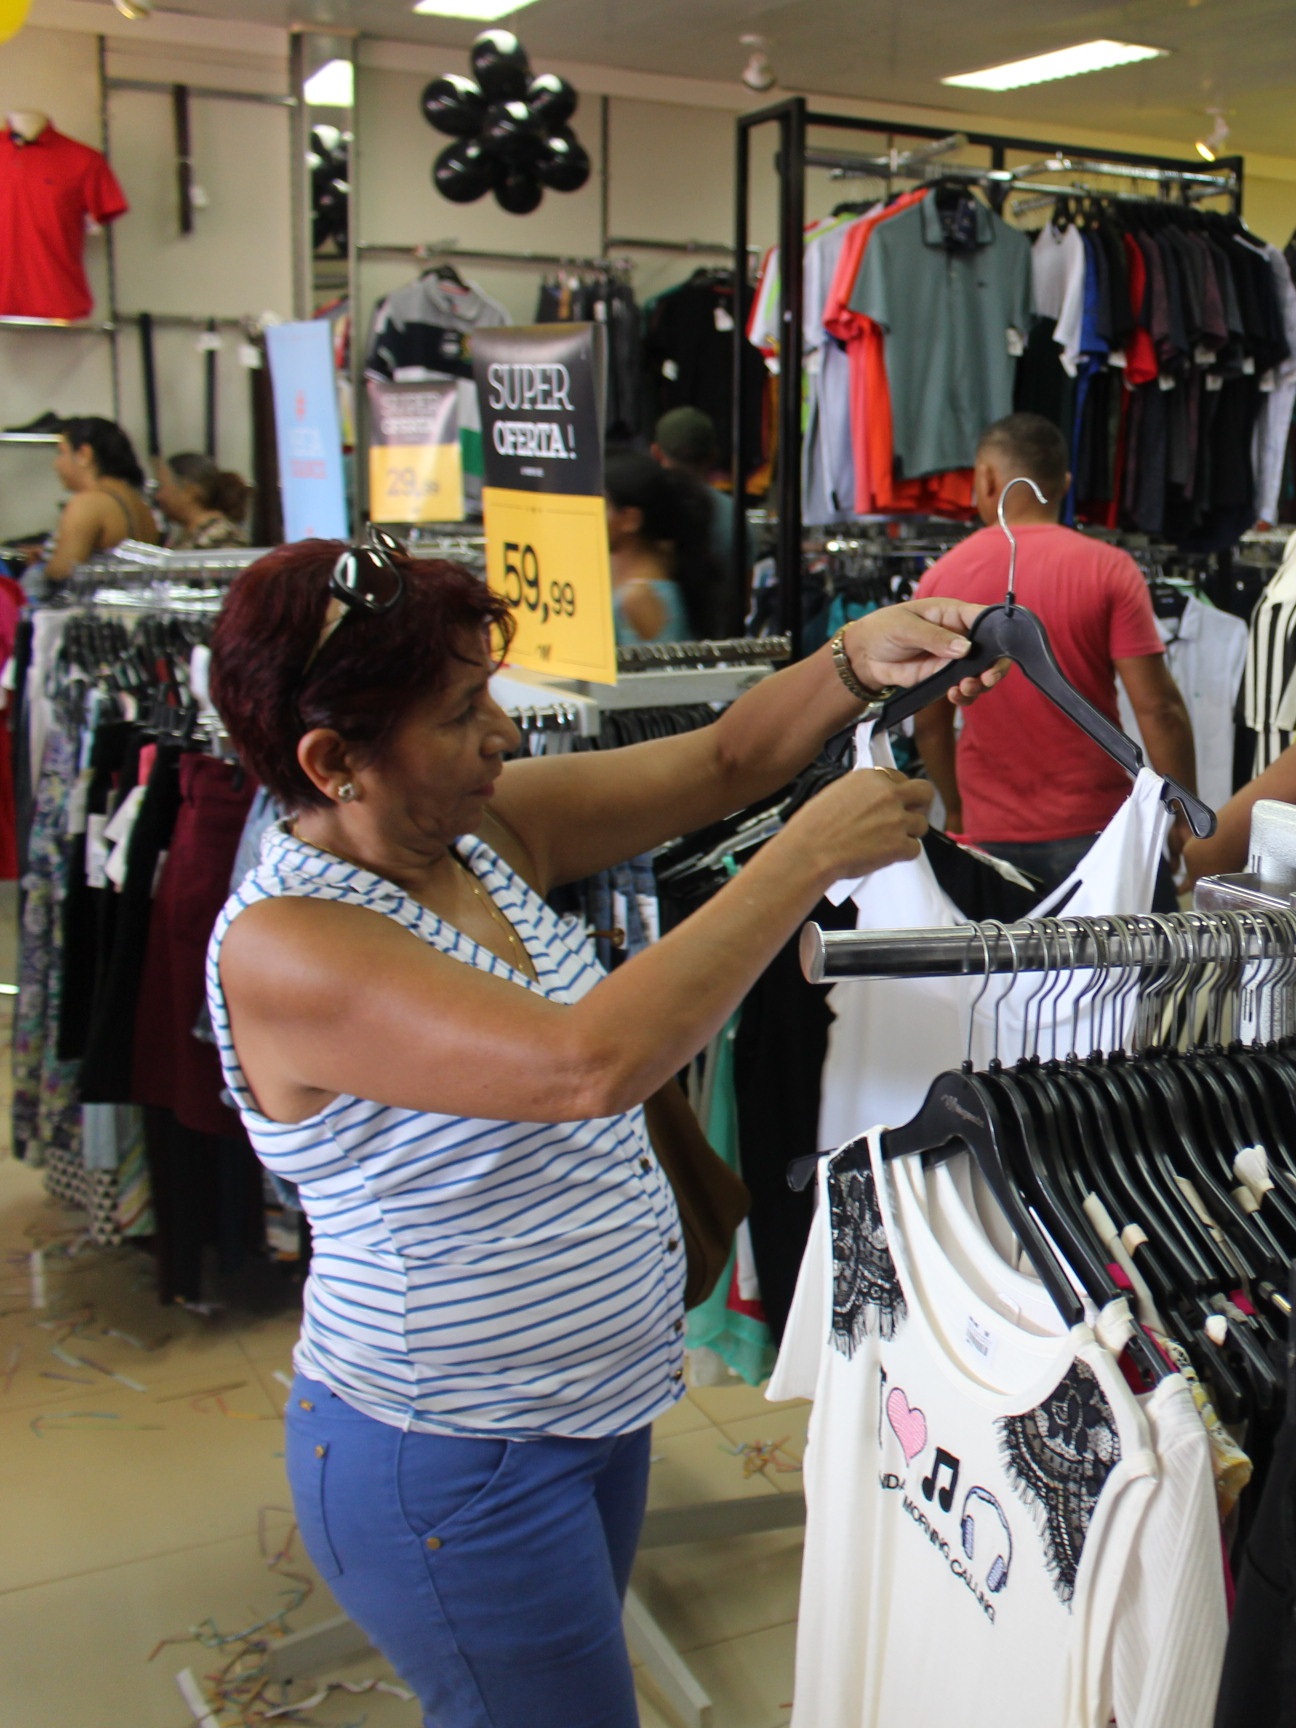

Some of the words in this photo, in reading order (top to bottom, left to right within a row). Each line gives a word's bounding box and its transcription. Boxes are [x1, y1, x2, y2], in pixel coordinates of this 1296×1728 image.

[487, 363, 576, 411] SUPER
[493, 420, 577, 460] OFERTA!
[503, 541, 576, 624] 59,99
[902, 1494, 951, 1560] MORNING
[950, 1558, 997, 1625] CALLING
